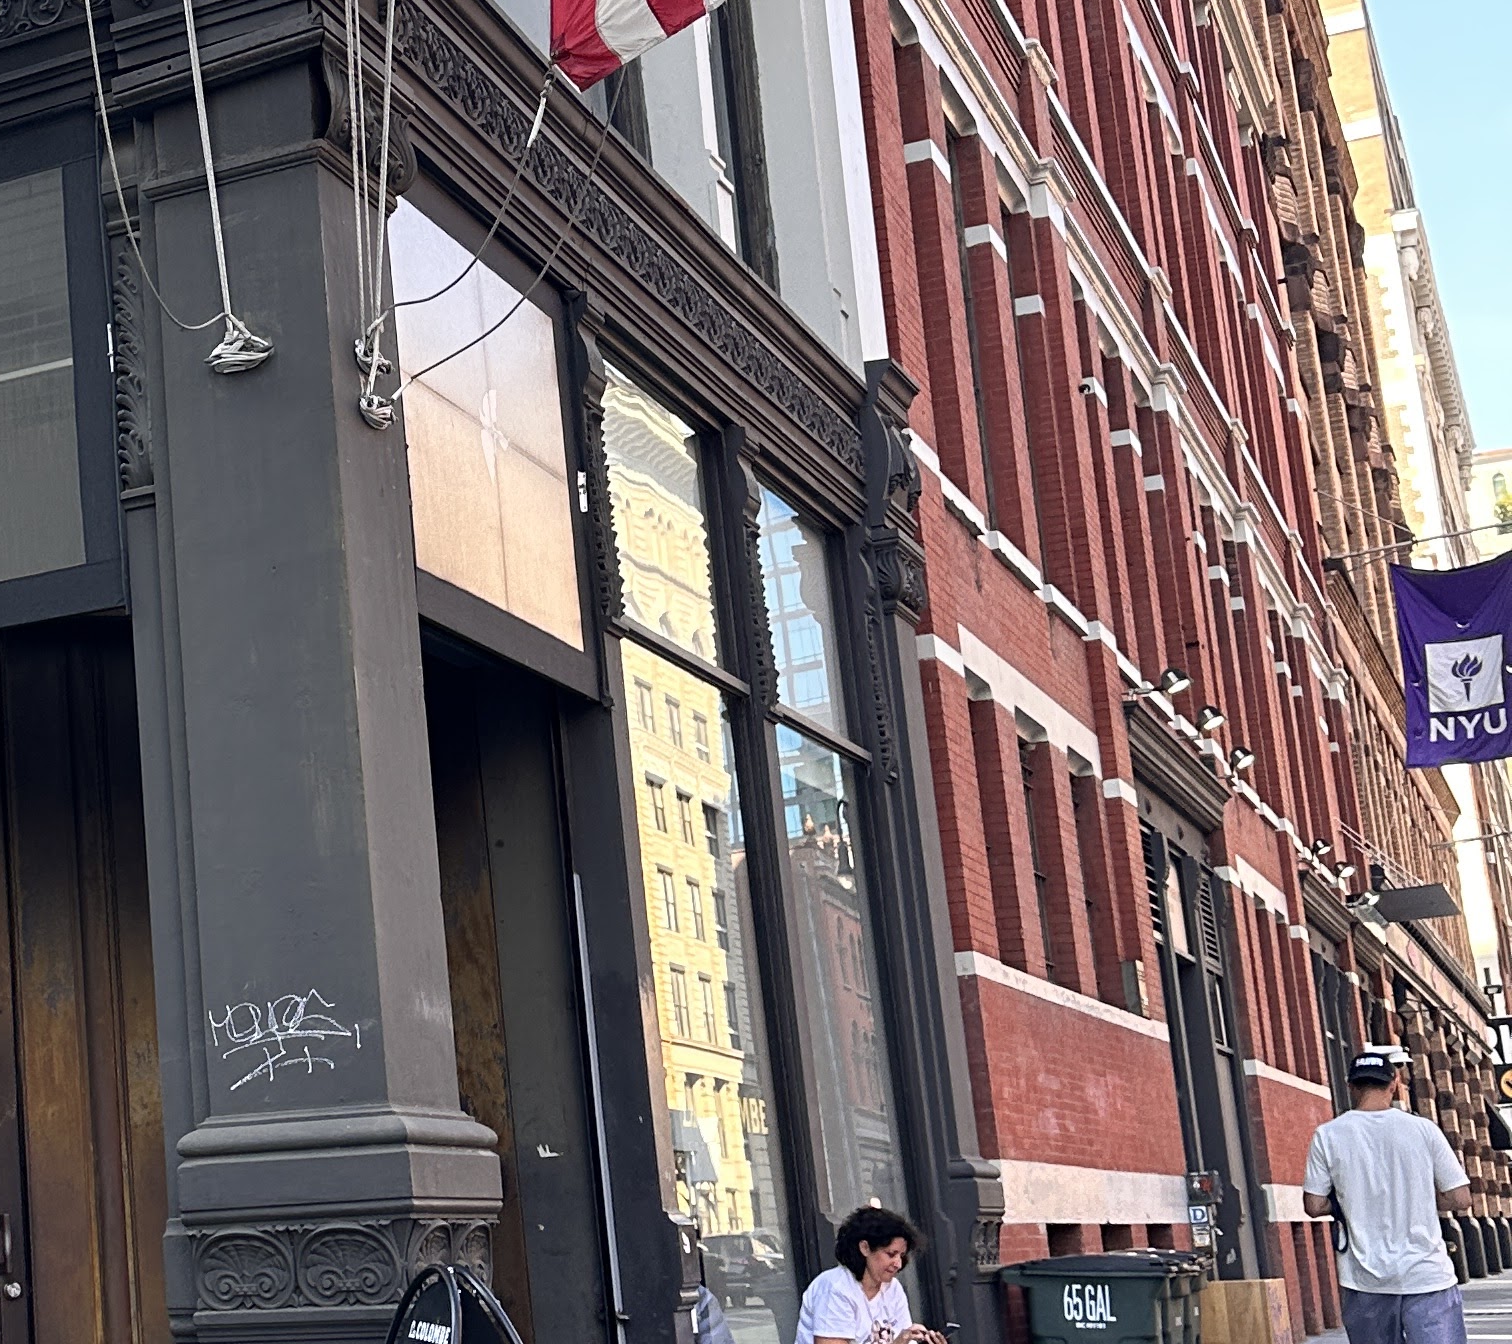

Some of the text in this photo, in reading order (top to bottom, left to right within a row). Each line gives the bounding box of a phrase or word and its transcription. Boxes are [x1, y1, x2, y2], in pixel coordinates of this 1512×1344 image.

[1429, 707, 1507, 743] NYU
[1063, 1284, 1117, 1322] 65 GAL
